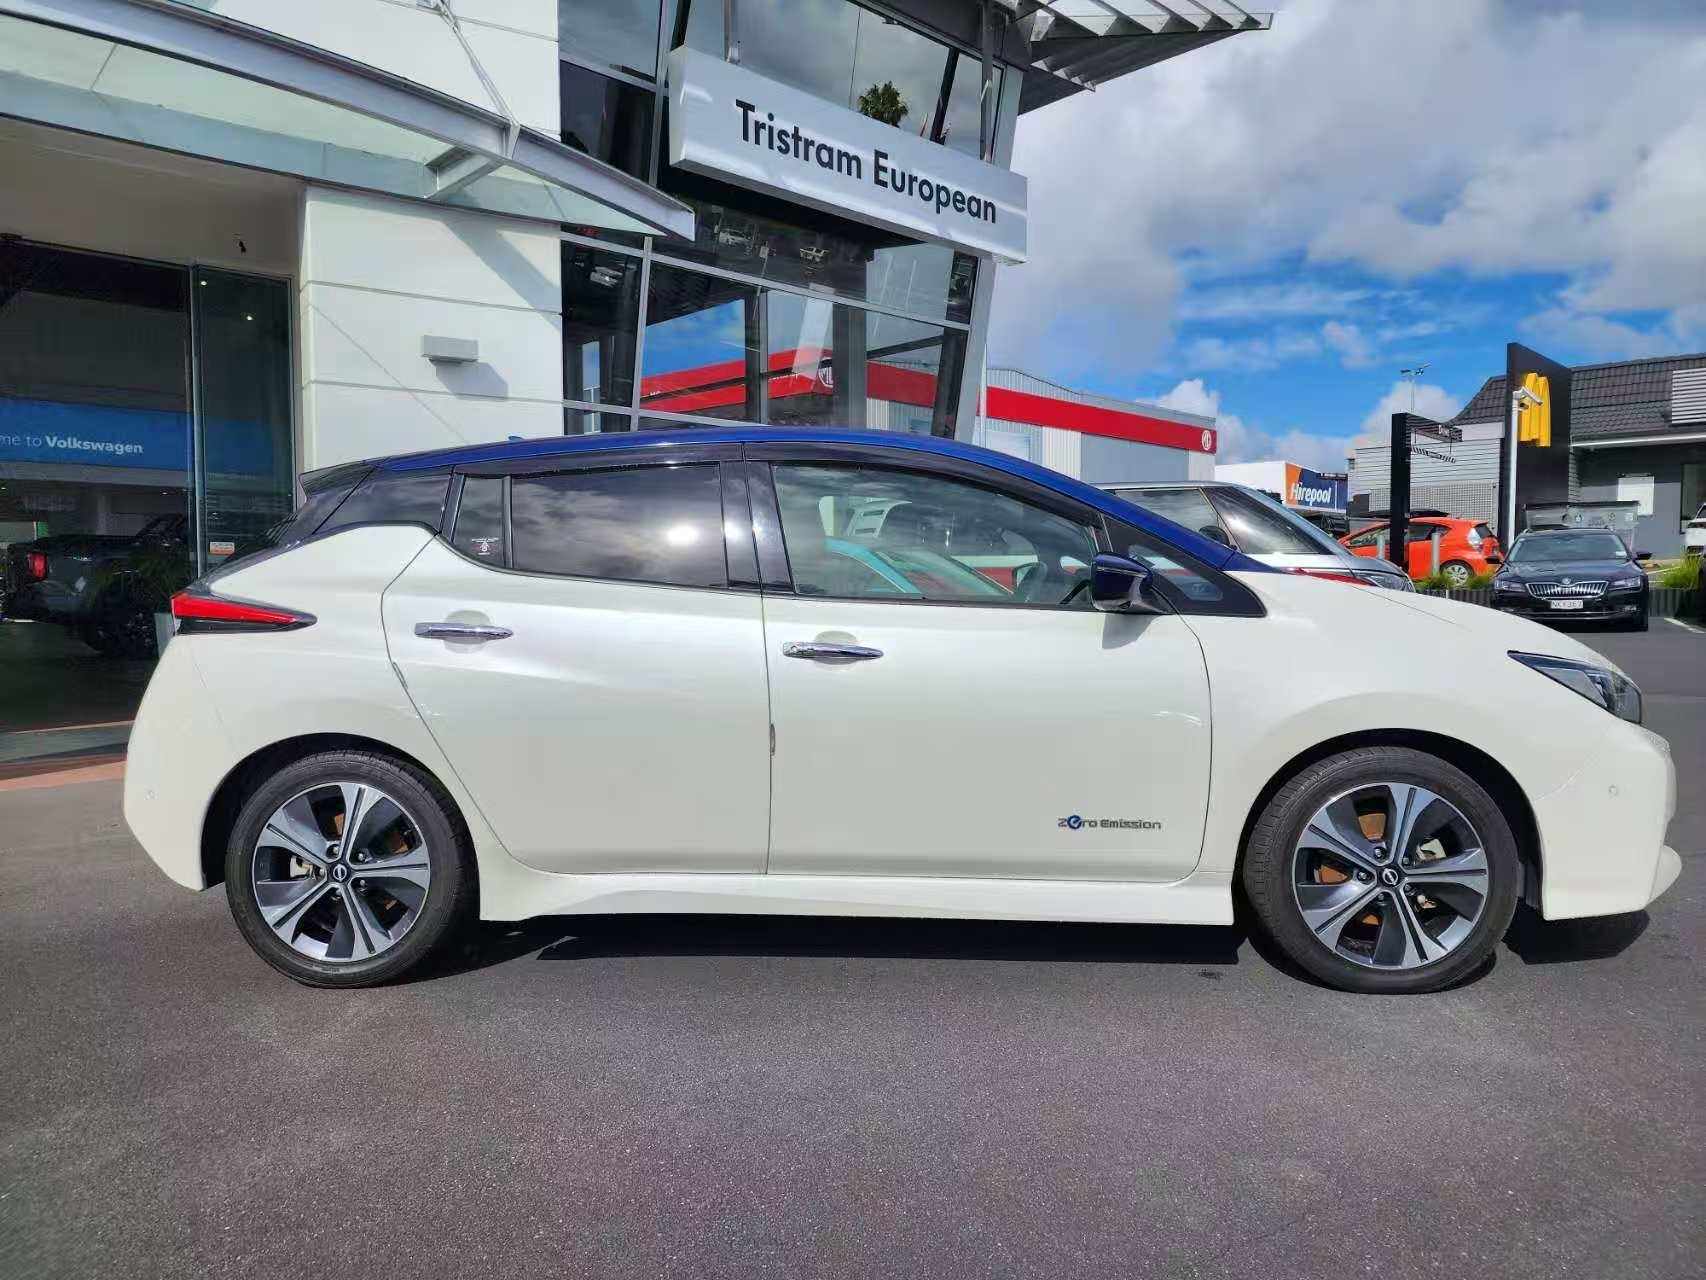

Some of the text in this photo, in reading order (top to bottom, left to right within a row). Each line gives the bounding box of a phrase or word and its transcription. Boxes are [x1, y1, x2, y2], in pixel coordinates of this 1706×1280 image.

[736, 99, 996, 223] Tristram European
[26, 436, 42, 447] to
[46, 436, 143, 454] Volkswagen
[1290, 481, 1332, 506] Hirepool
[1100, 819, 1161, 829] Emission
